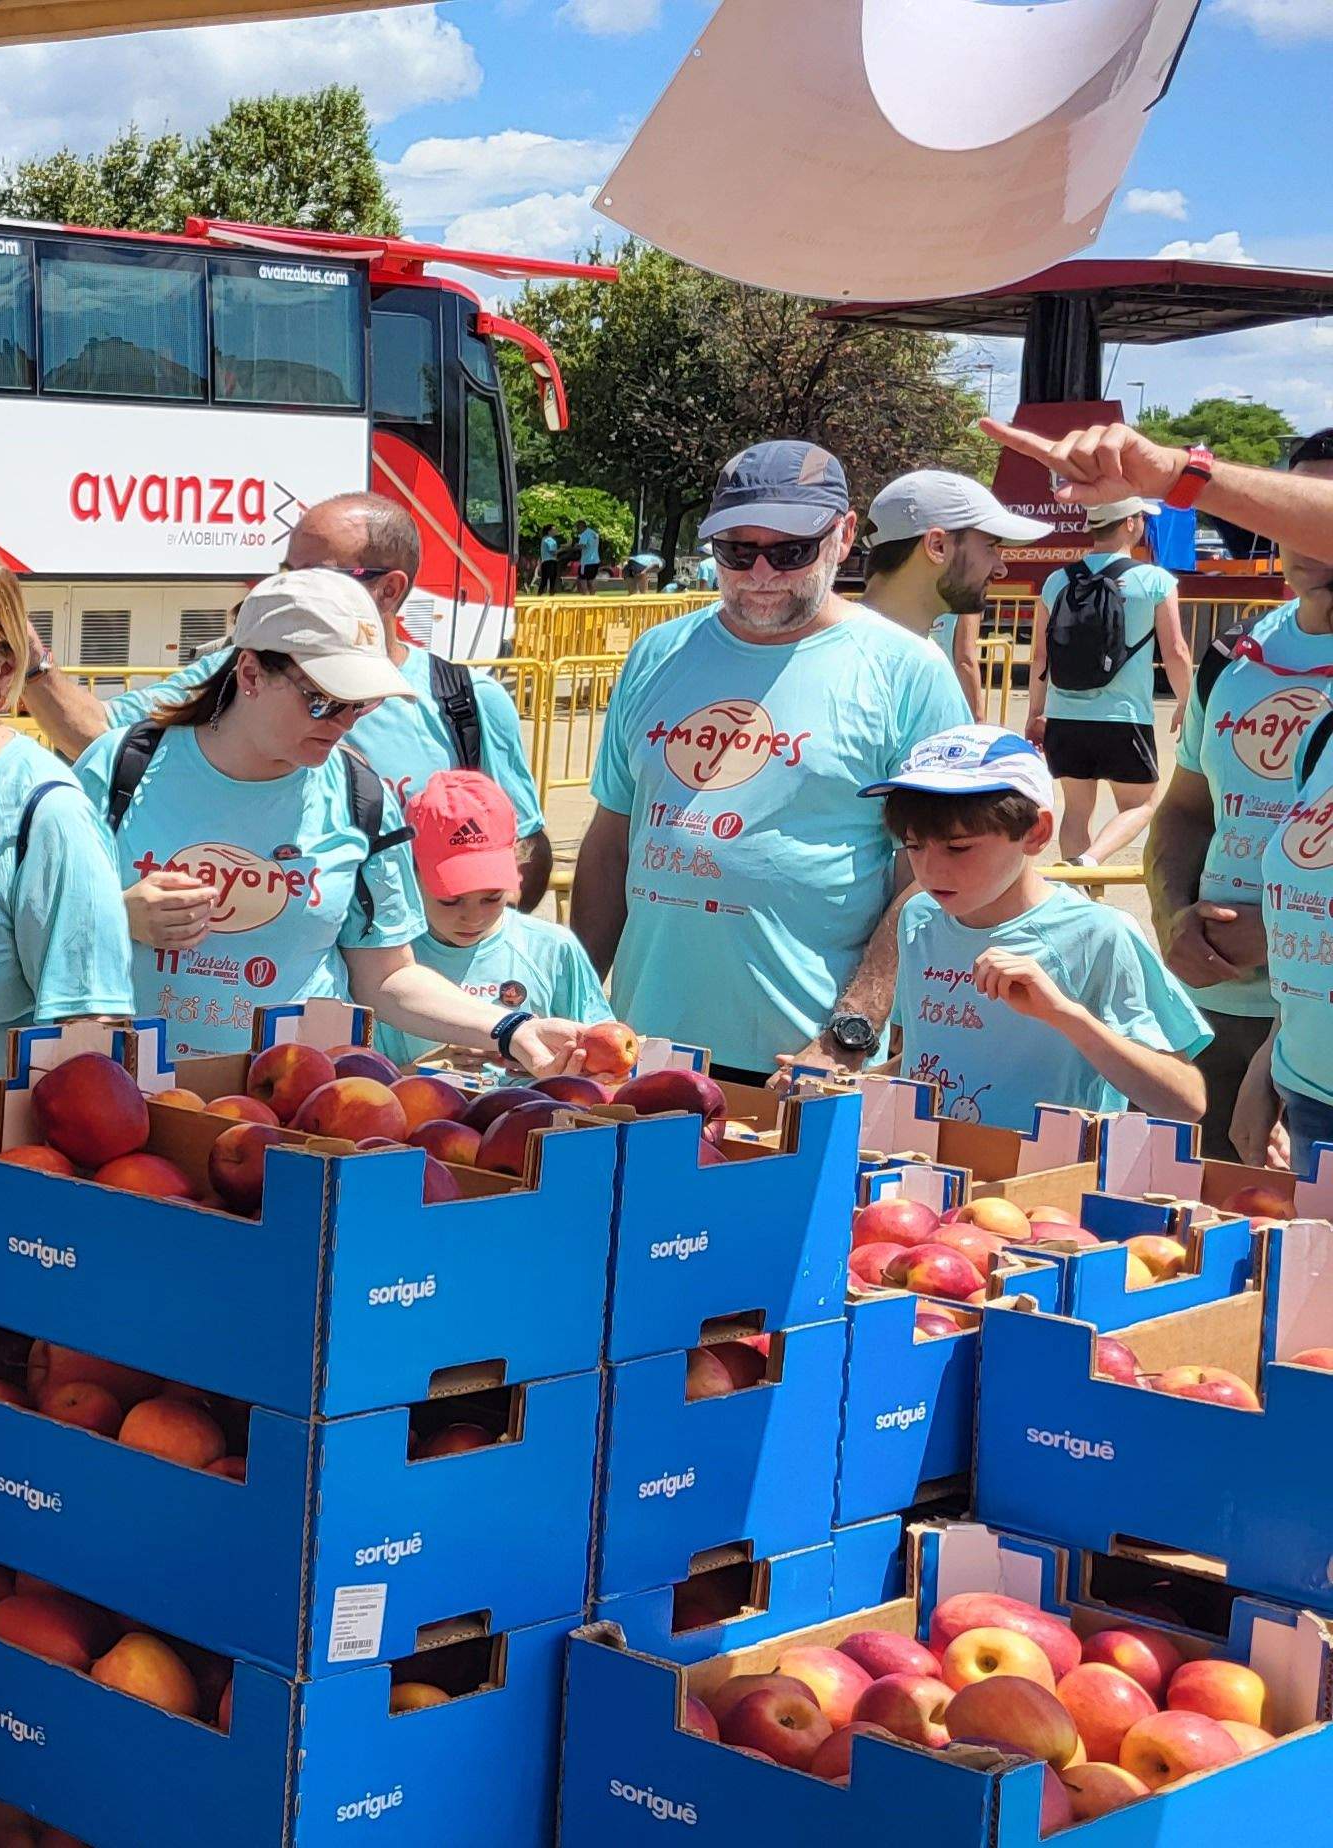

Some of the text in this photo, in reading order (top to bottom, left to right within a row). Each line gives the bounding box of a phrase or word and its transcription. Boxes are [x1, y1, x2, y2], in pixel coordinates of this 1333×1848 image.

[258, 264, 349, 286] avanzabus.com
[69, 472, 266, 525] avanza
[179, 531, 238, 546] MOBILITY
[240, 533, 266, 546] ADO
[449, 834, 489, 846] adidas
[923, 966, 976, 993] +mayo
